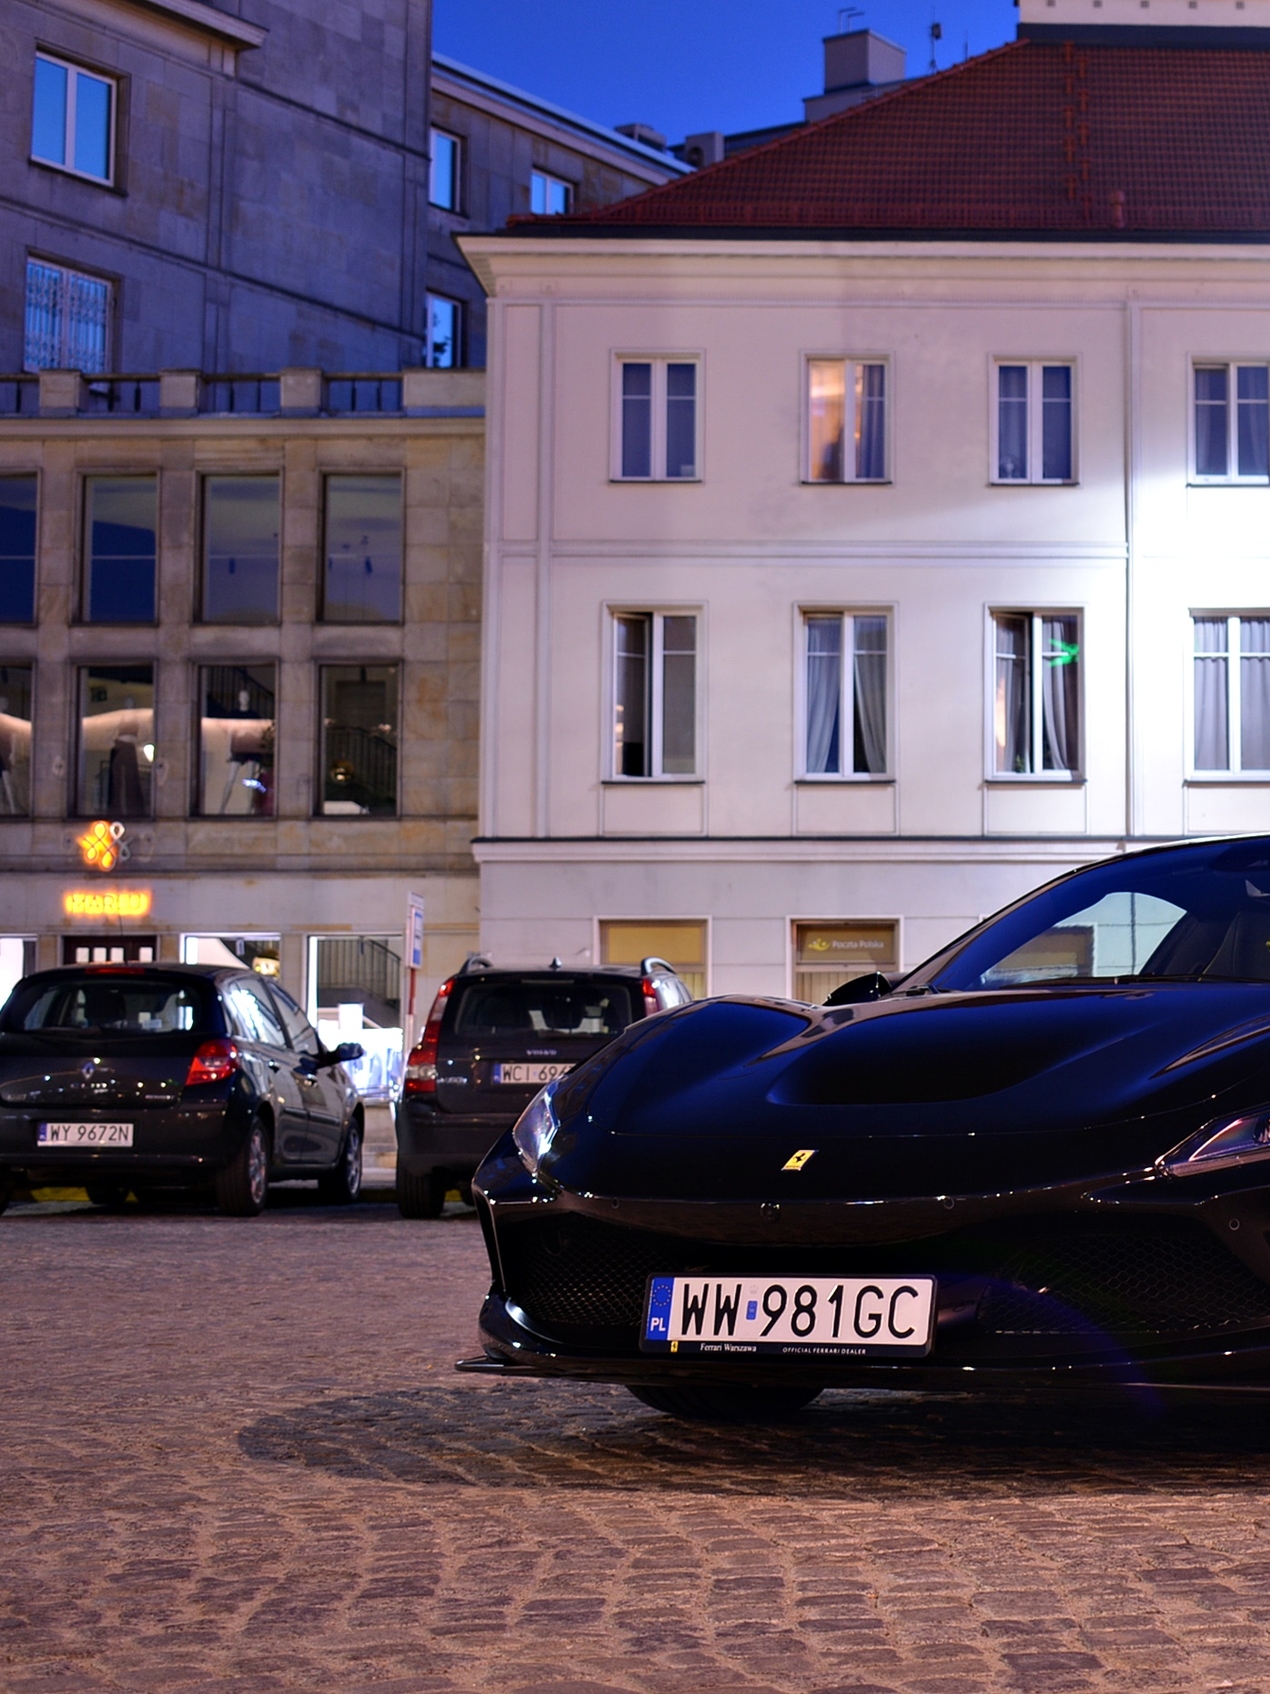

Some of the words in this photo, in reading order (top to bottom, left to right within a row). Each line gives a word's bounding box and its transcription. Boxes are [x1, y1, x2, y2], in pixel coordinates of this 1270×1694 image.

[832, 940, 858, 949] Poczta
[859, 940, 884, 949] Polska
[503, 1065, 530, 1082] WCI
[50, 1125, 71, 1141] WY
[77, 1125, 129, 1141] 9672N
[681, 1283, 743, 1337] WW
[759, 1284, 919, 1340] 981GC
[650, 1316, 666, 1332] PL
[700, 1342, 723, 1352] Ferrari
[724, 1343, 757, 1353] Warszawa
[782, 1346, 812, 1354] OFFICIAL
[812, 1347, 840, 1355] FERRARI
[840, 1348, 867, 1356] DEALER
